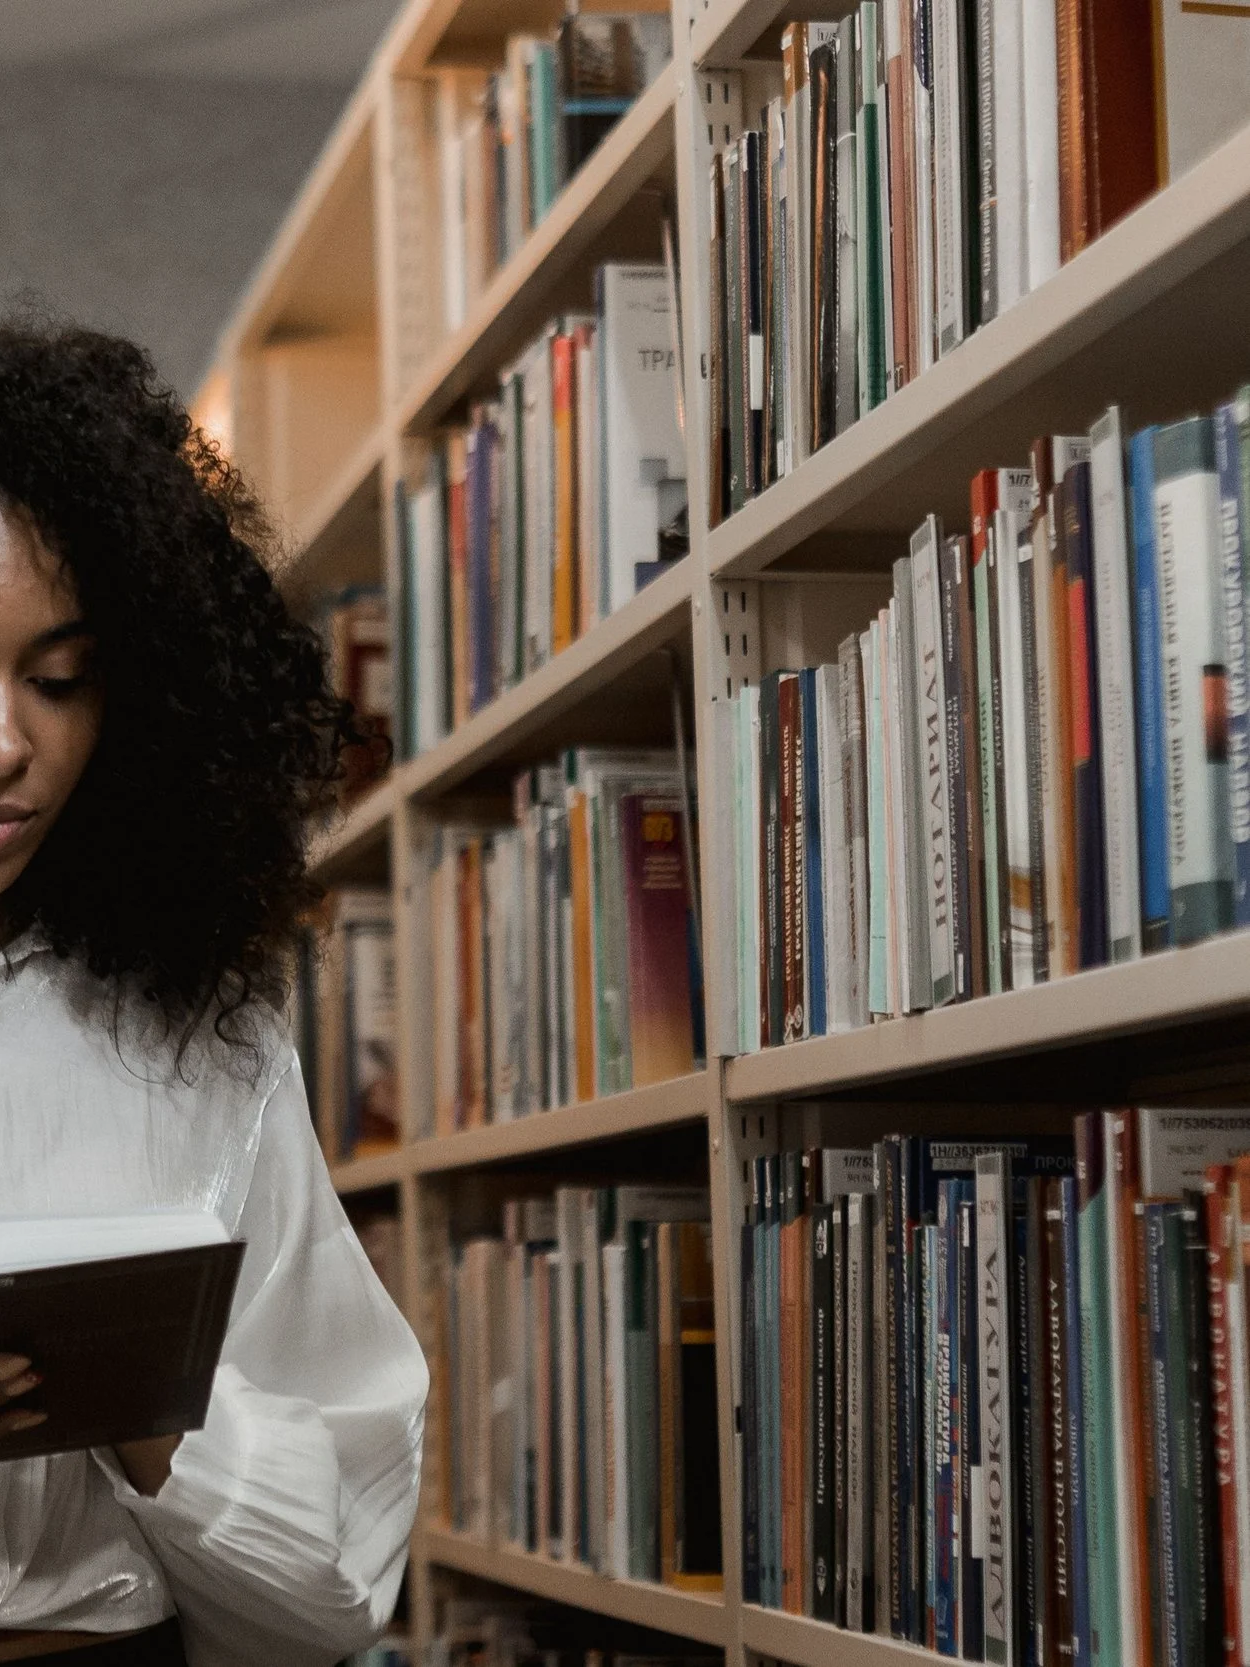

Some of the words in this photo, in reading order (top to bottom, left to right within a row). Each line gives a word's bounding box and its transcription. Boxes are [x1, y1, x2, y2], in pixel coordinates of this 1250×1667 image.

[1161, 503, 1178, 645] НАСТОЛЬНАЯ
[1168, 656, 1182, 728] КНИГА
[923, 645, 947, 927] НОТАРИАТ
[981, 700, 990, 818] НОТАРИАТ
[1171, 736, 1186, 867] ПРОКУРОРА
[817, 1308, 825, 1368] надзор
[889, 1268, 897, 1360] БЕЛАРУСЬ
[1050, 1279, 1062, 1452] АДВОКАТУРА
[1207, 1251, 1231, 1485] АДВОКАТУРА
[816, 1375, 825, 1505] Прокурорский
[890, 1364, 898, 1487] РЕСПУБЛИКИ
[985, 1249, 1004, 1630] АДВОКАТУРА
[1055, 1459, 1063, 1474] В
[1158, 1360, 1168, 1475] АДВОКАТУРА
[1164, 1478, 1174, 1597] РЕСПУБЛИКИ
[892, 1491, 900, 1621] ПРОКУРАТУРА
[1056, 1482, 1067, 1598] РОССИИ
